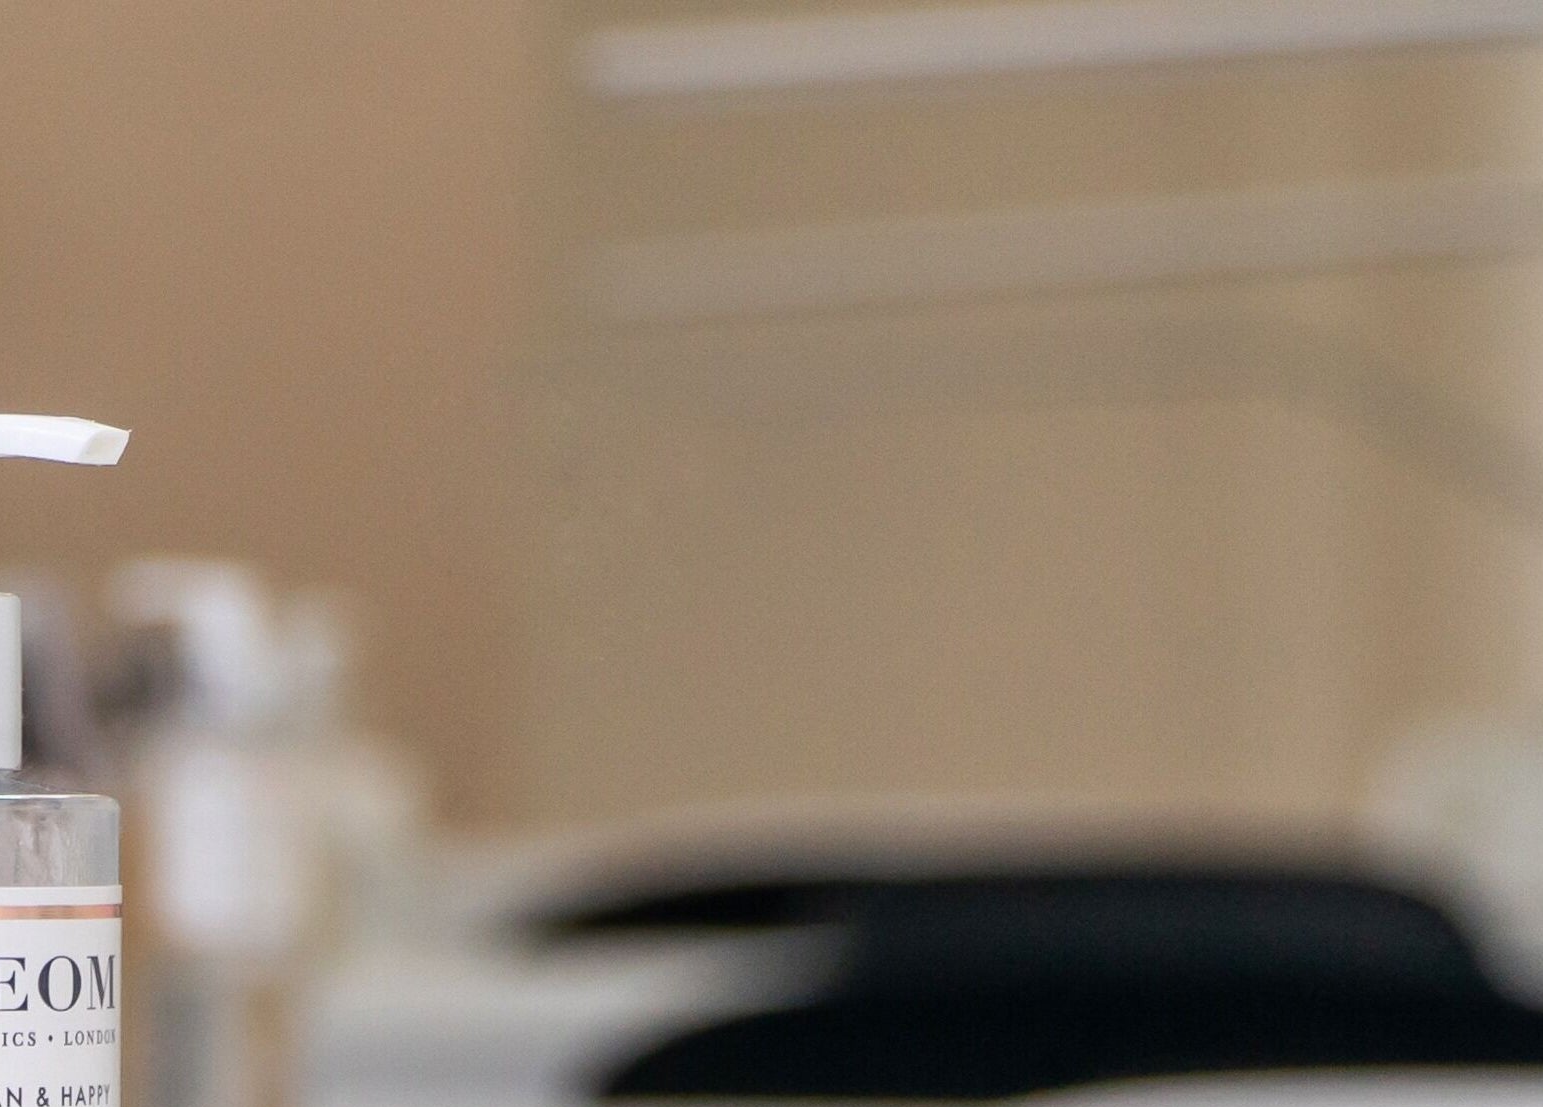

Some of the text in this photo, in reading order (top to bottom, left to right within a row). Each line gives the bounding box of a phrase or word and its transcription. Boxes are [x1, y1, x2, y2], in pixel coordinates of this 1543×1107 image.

[64, 1030, 115, 1046] LONDON
[37, 1087, 50, 1107] &
[62, 1085, 109, 1106] HAPPY
